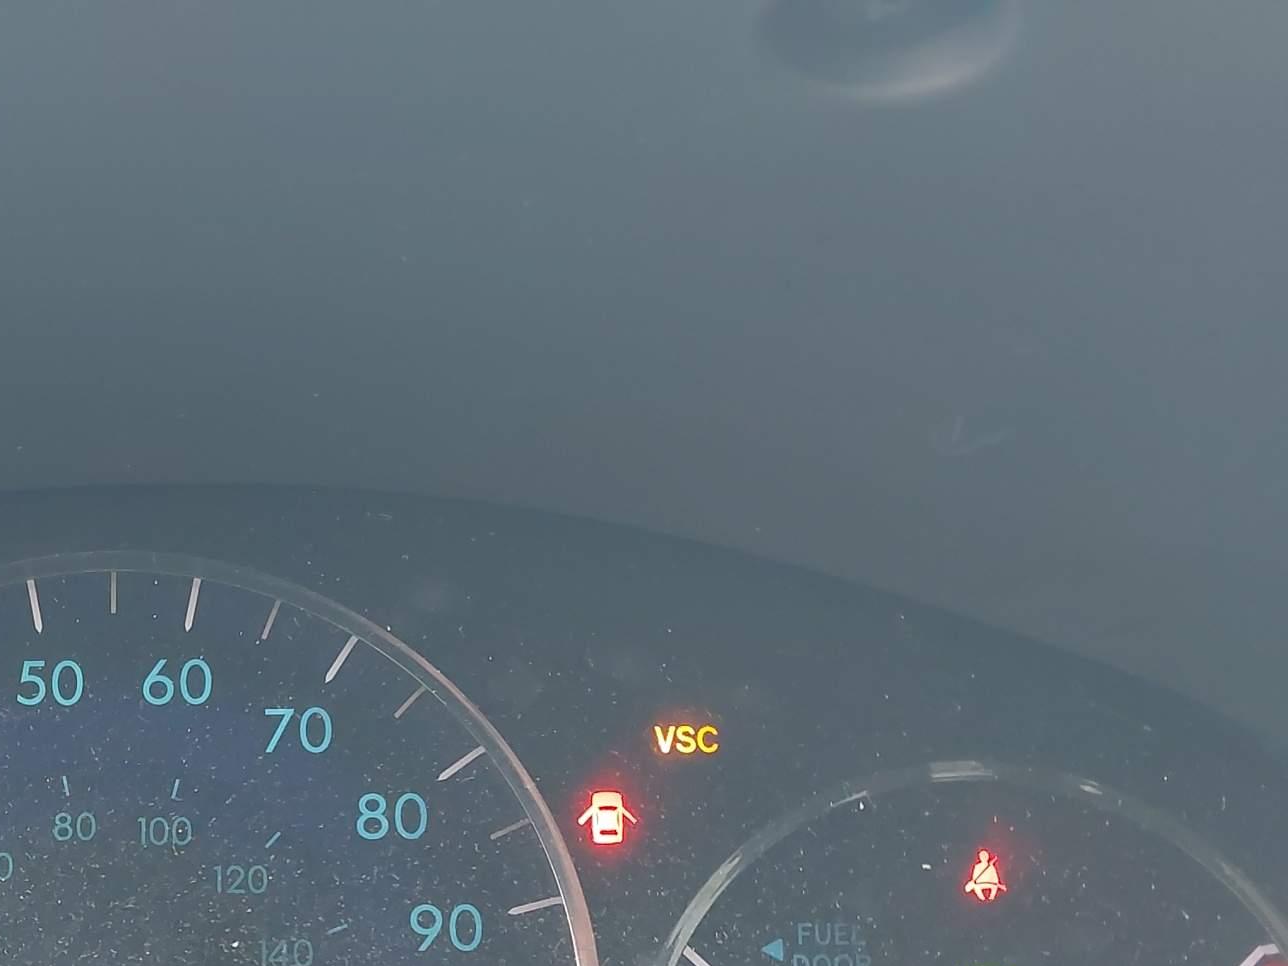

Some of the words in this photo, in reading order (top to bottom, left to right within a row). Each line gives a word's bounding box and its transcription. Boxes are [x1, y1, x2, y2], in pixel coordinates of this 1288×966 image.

[16, 659, 84, 707] 50
[141, 658, 213, 706] 60
[263, 706, 333, 754] 70
[654, 724, 719, 755] VSC
[51, 811, 98, 843] 80
[136, 816, 193, 848] 100
[355, 792, 428, 841] 80
[213, 864, 269, 896] 120
[408, 903, 483, 953] 90
[796, 922, 866, 946] FUEL
